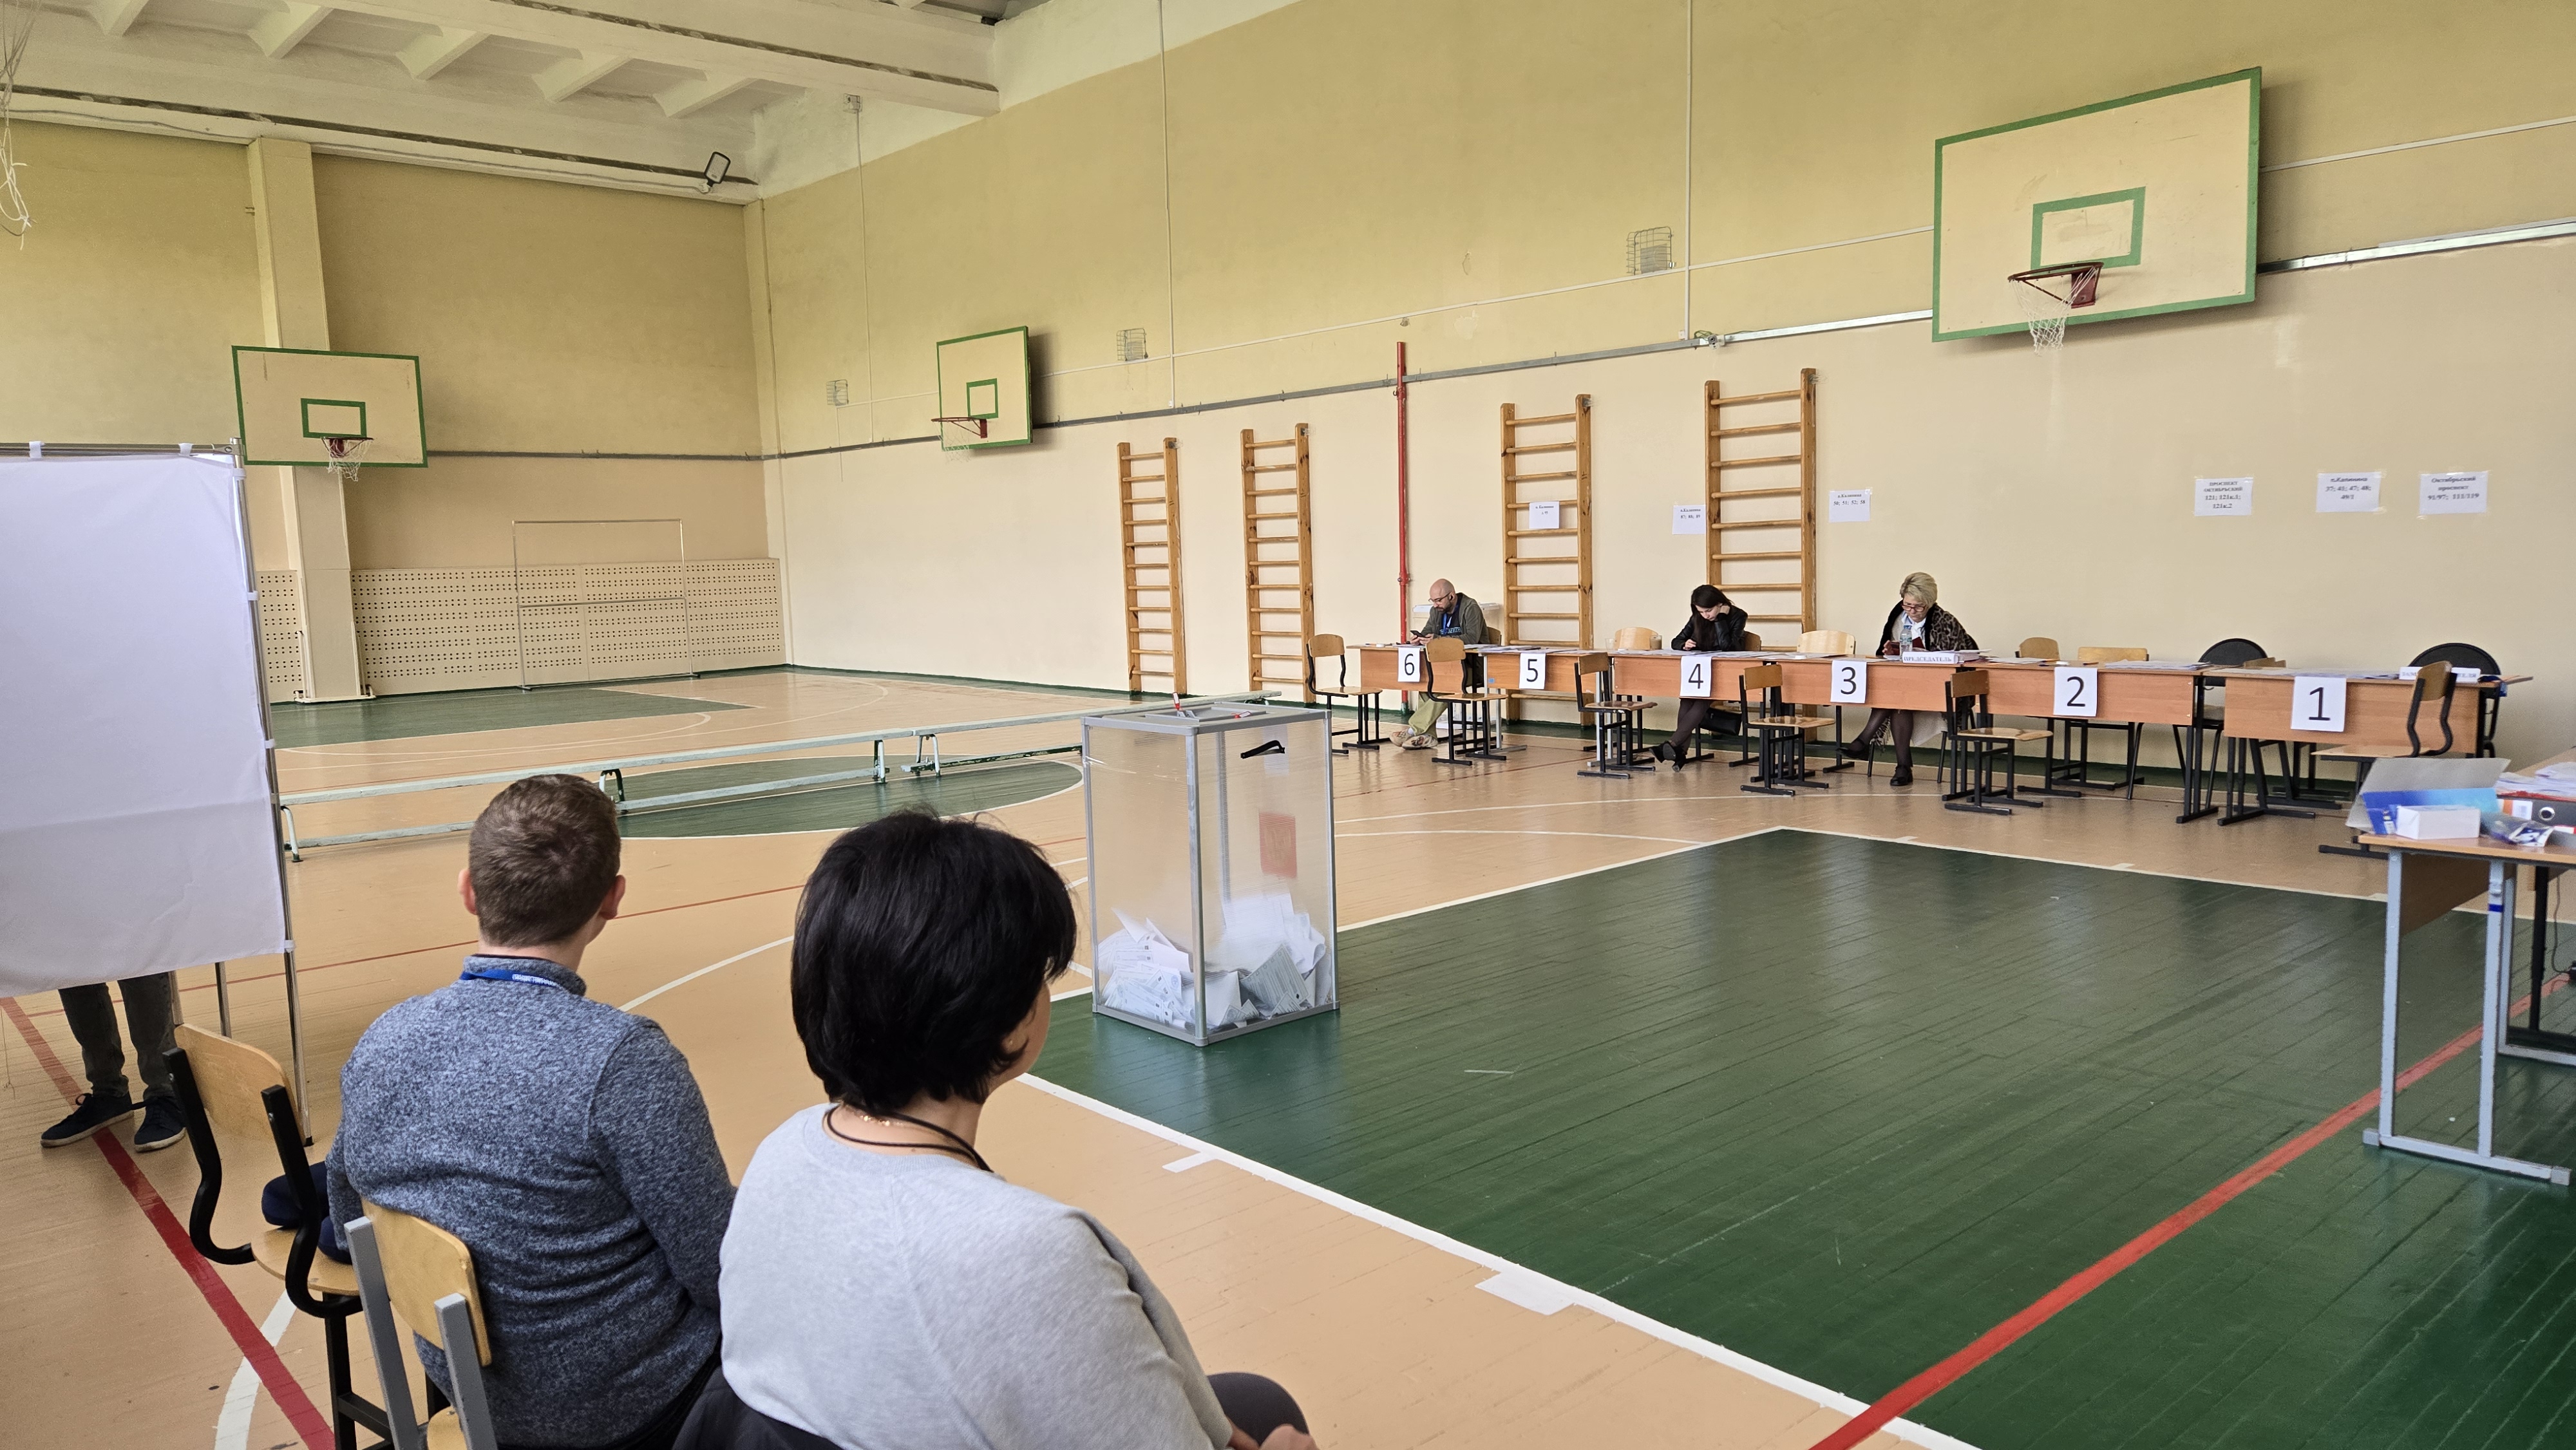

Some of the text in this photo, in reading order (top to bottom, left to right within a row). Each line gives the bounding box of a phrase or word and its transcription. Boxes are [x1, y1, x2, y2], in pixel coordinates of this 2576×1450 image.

[1405, 654, 1415, 676] 6
[1526, 659, 1539, 683] 5
[1688, 663, 1704, 689] 4
[1841, 666, 1857, 695] 3
[2067, 676, 2085, 707] 2
[2309, 687, 2330, 721] 1
